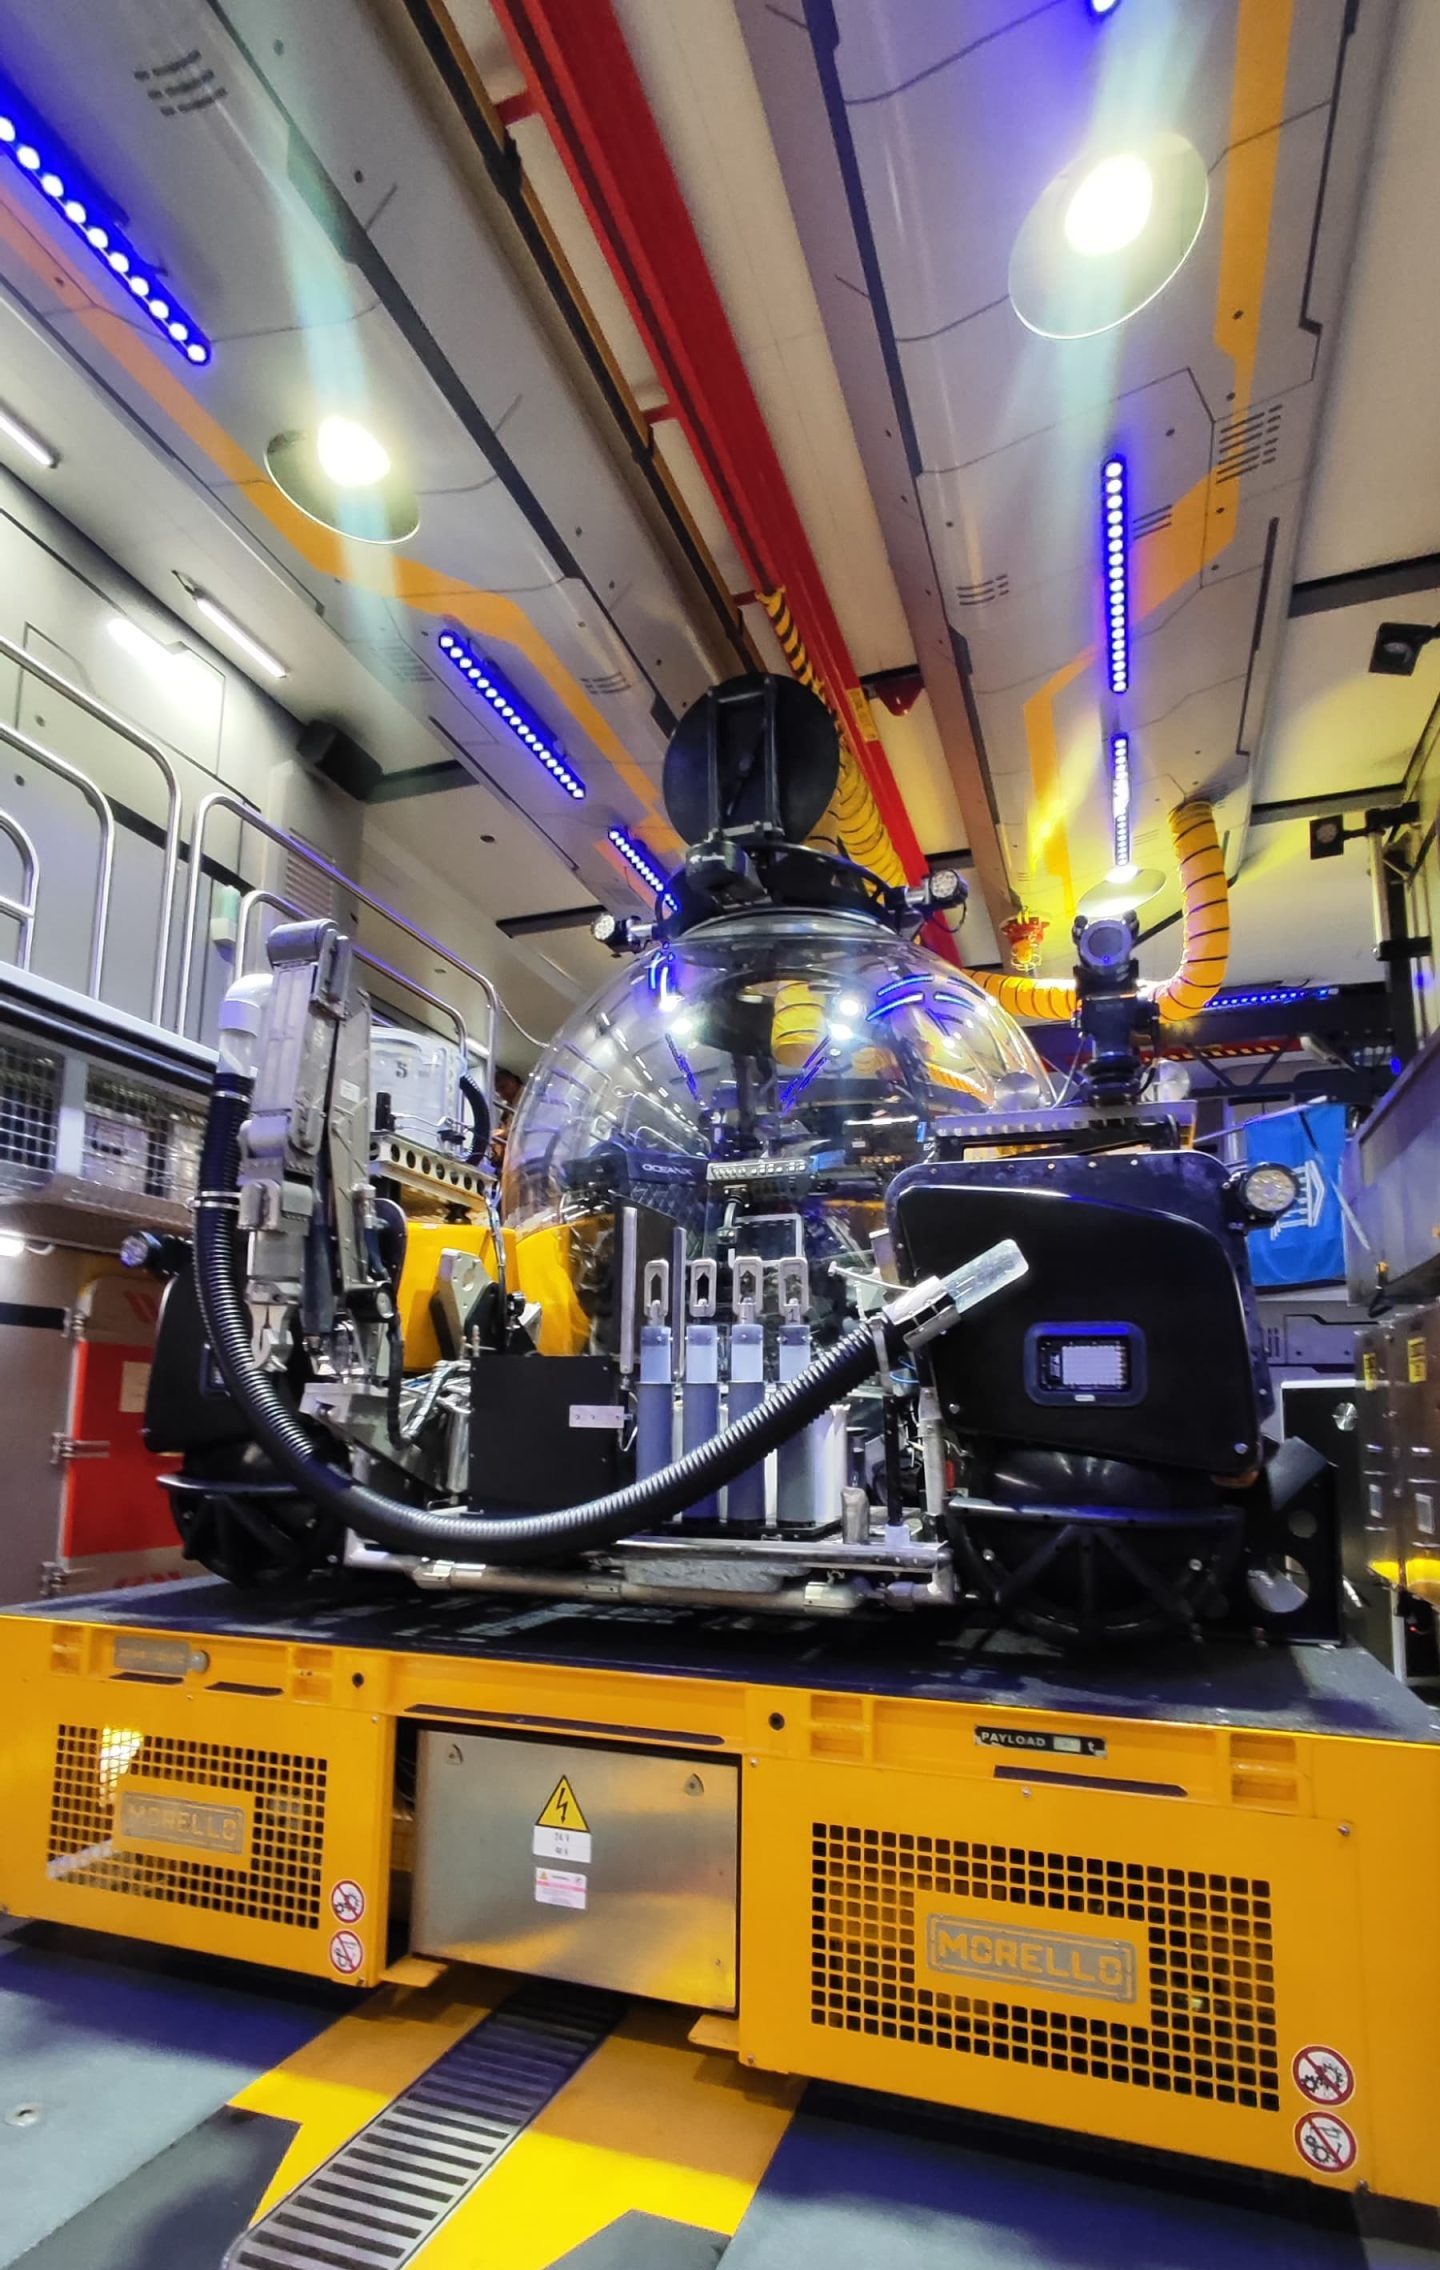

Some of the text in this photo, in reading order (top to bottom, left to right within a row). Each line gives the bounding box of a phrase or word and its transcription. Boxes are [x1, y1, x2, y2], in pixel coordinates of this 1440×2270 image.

[641, 1163, 695, 1177] OCEANX
[980, 1731, 1046, 1747] PAYLOAD
[127, 1803, 237, 1841] MORELLO
[938, 1929, 1123, 1986] MORELLO
